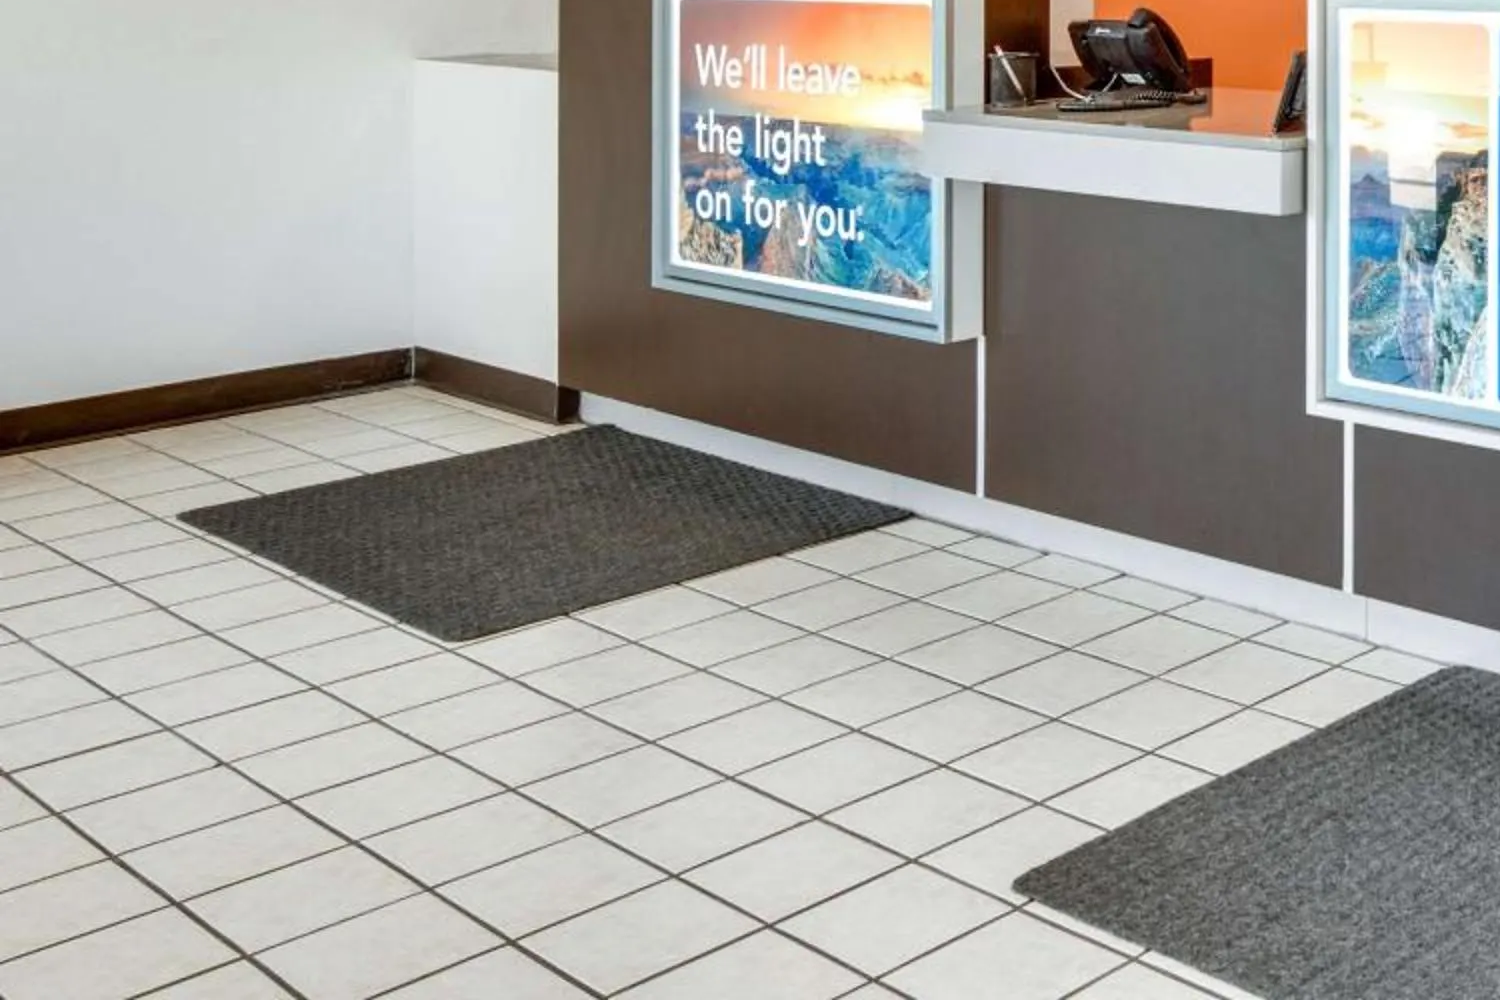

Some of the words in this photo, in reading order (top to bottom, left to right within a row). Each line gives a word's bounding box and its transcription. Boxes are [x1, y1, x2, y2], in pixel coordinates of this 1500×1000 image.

[695, 43, 766, 90] We'll
[778, 45, 861, 96] leave
[695, 109, 743, 157] the
[755, 112, 826, 175] light
[695, 188, 731, 222] on
[743, 180, 787, 229] for
